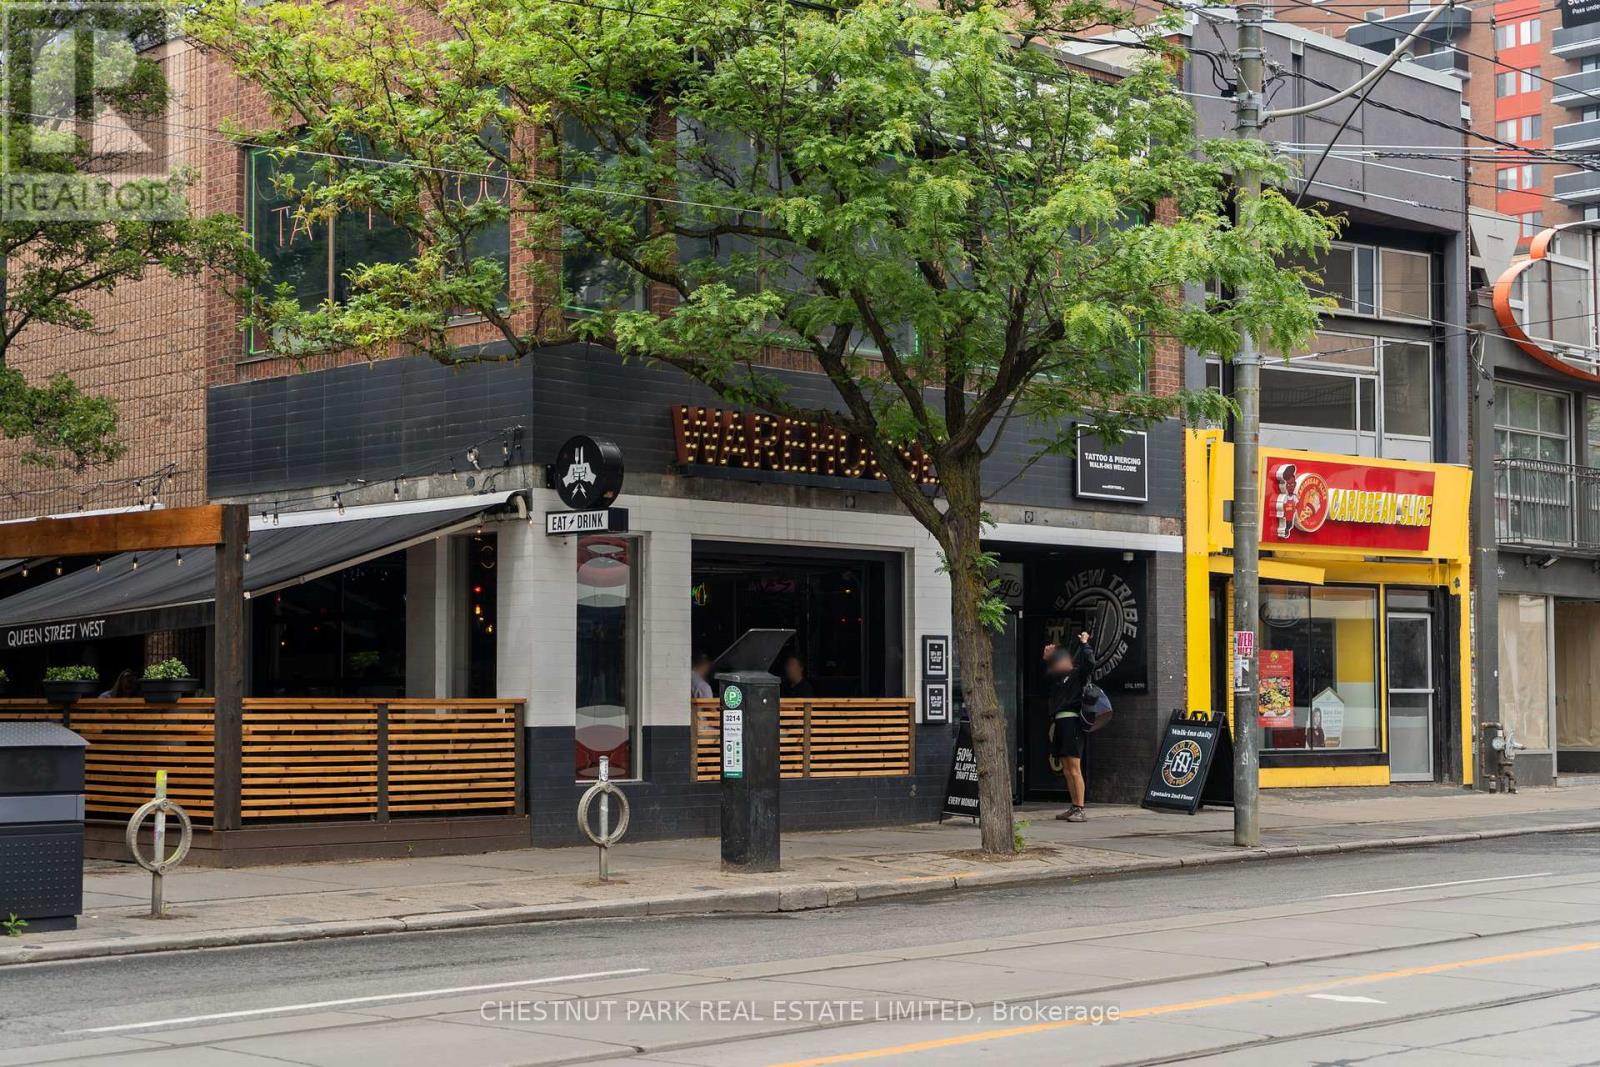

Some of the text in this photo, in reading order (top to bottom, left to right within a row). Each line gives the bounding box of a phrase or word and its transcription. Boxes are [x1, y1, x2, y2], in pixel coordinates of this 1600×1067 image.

[1085, 453, 1141, 465] TATTOO & PIERCING
[1114, 464, 1137, 472] WELCOME
[1329, 488, 1432, 526] CARIBBEAN SLICE
[552, 513, 603, 531] EAT DRINK
[1065, 568, 1105, 598] NEW
[1108, 574, 1138, 639] TRIBE
[8, 620, 105, 646] QUEEN STREET WEST
[725, 714, 741, 722] 3214
[1197, 731, 1212, 739] daily
[957, 748, 972, 761] 50%
[968, 773, 979, 781] BEE
[948, 796, 961, 805] EVERY
